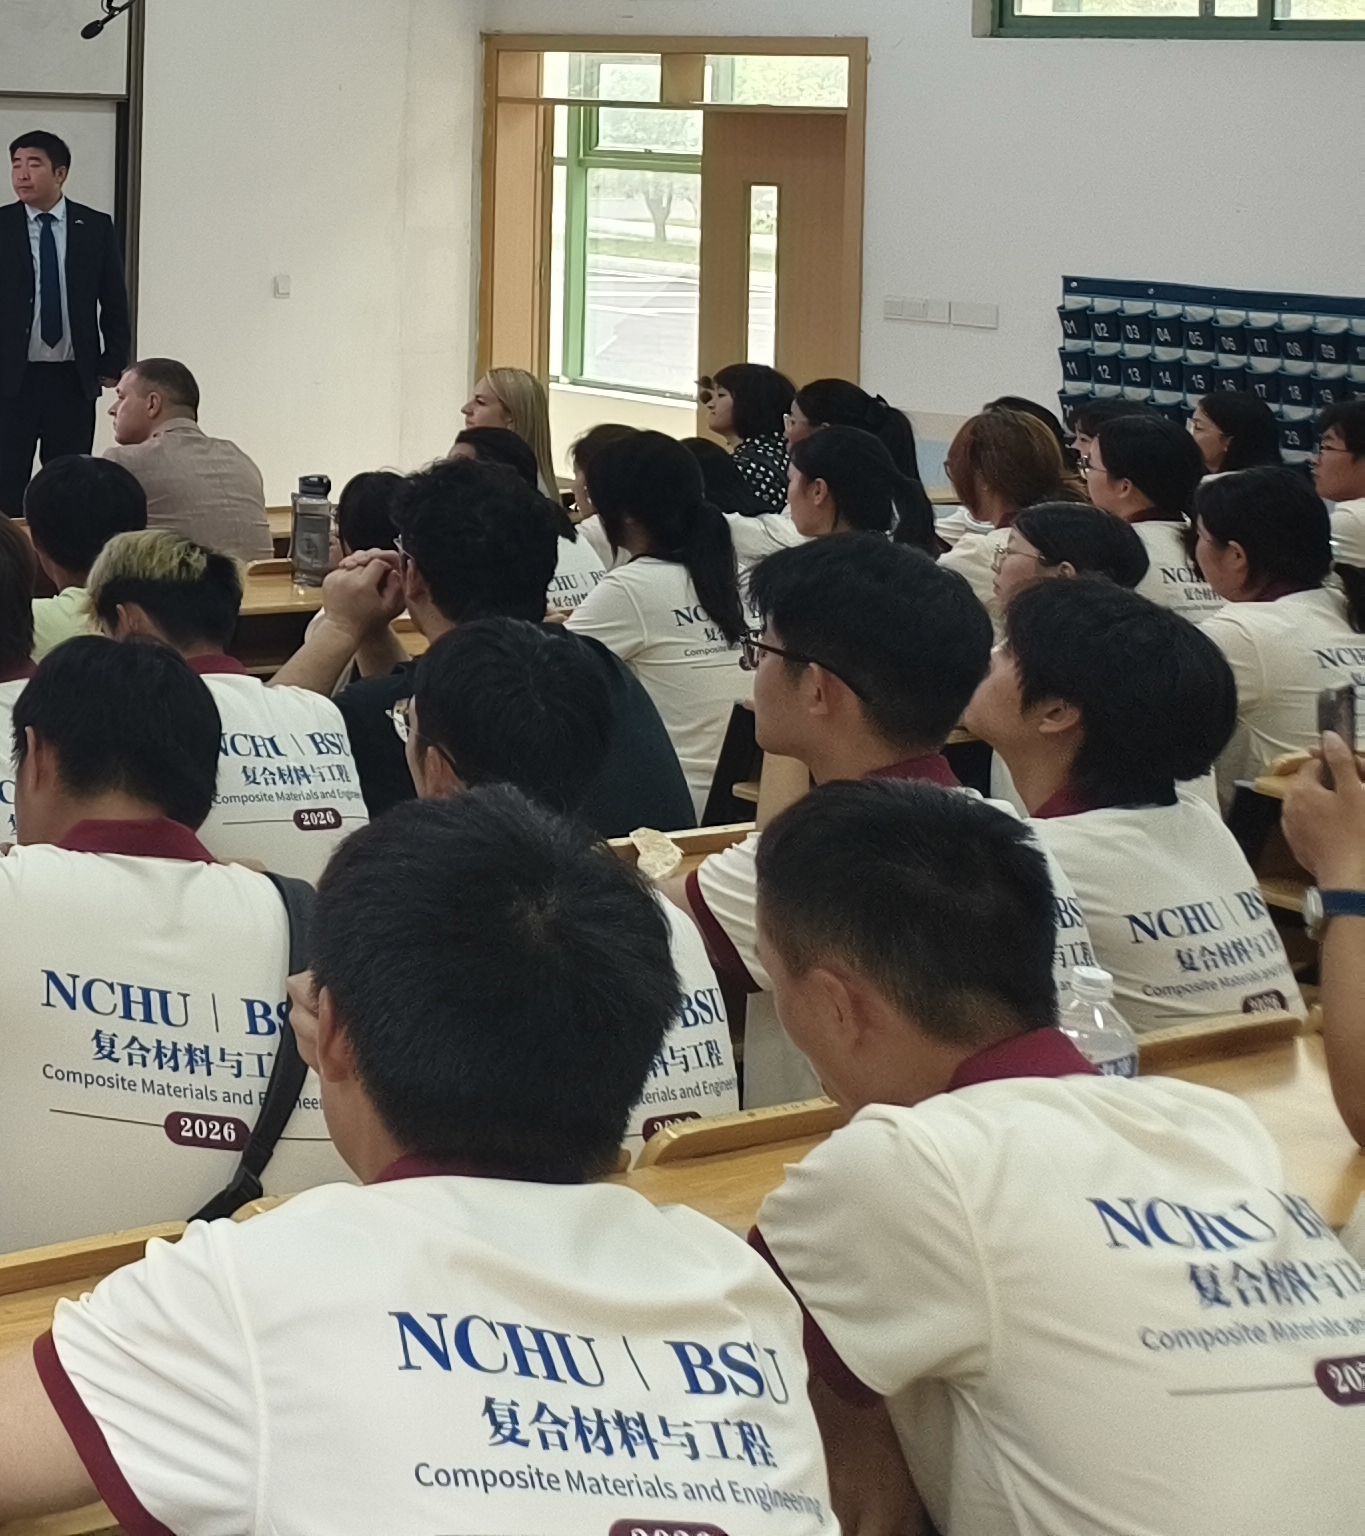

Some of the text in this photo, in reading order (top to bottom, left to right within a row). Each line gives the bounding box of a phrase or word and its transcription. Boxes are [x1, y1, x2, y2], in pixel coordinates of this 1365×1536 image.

[1064, 320, 1077, 334] 01
[1095, 323, 1109, 337] 02
[1126, 325, 1140, 339] 03
[1157, 327, 1171, 342] 04
[1189, 331, 1203, 346] 05
[1221, 337, 1236, 351] 06
[1254, 338, 1268, 353] 07
[1286, 342, 1303, 357] 08
[1067, 362, 1078, 376] 11
[1098, 365, 1111, 379] 12
[1128, 368, 1141, 382] 13
[1159, 371, 1172, 385] 14
[1192, 375, 1205, 390] 15
[1254, 384, 1267, 398] 17
[1288, 386, 1302, 400] 18
[214, 789, 336, 805] Composite Materials and
[301, 811, 335, 825] 2026
[1125, 901, 1224, 944] NCHU
[40, 969, 190, 1027] NCHU
[91, 1028, 273, 1079] 复合材料与工
[42, 1063, 137, 1093] Composite
[141, 1077, 218, 1104] Materials
[222, 1088, 253, 1105] and
[640, 1083, 701, 1105] terials and
[179, 1117, 236, 1143] 2026
[1085, 1196, 1277, 1252] NCHU
[1139, 1321, 1267, 1352] Composite
[388, 1311, 790, 1405] NCHU BSU
[481, 1395, 778, 1469] 复合材料与工程
[414, 1462, 825, 1526] Composite Materials and Engineering
